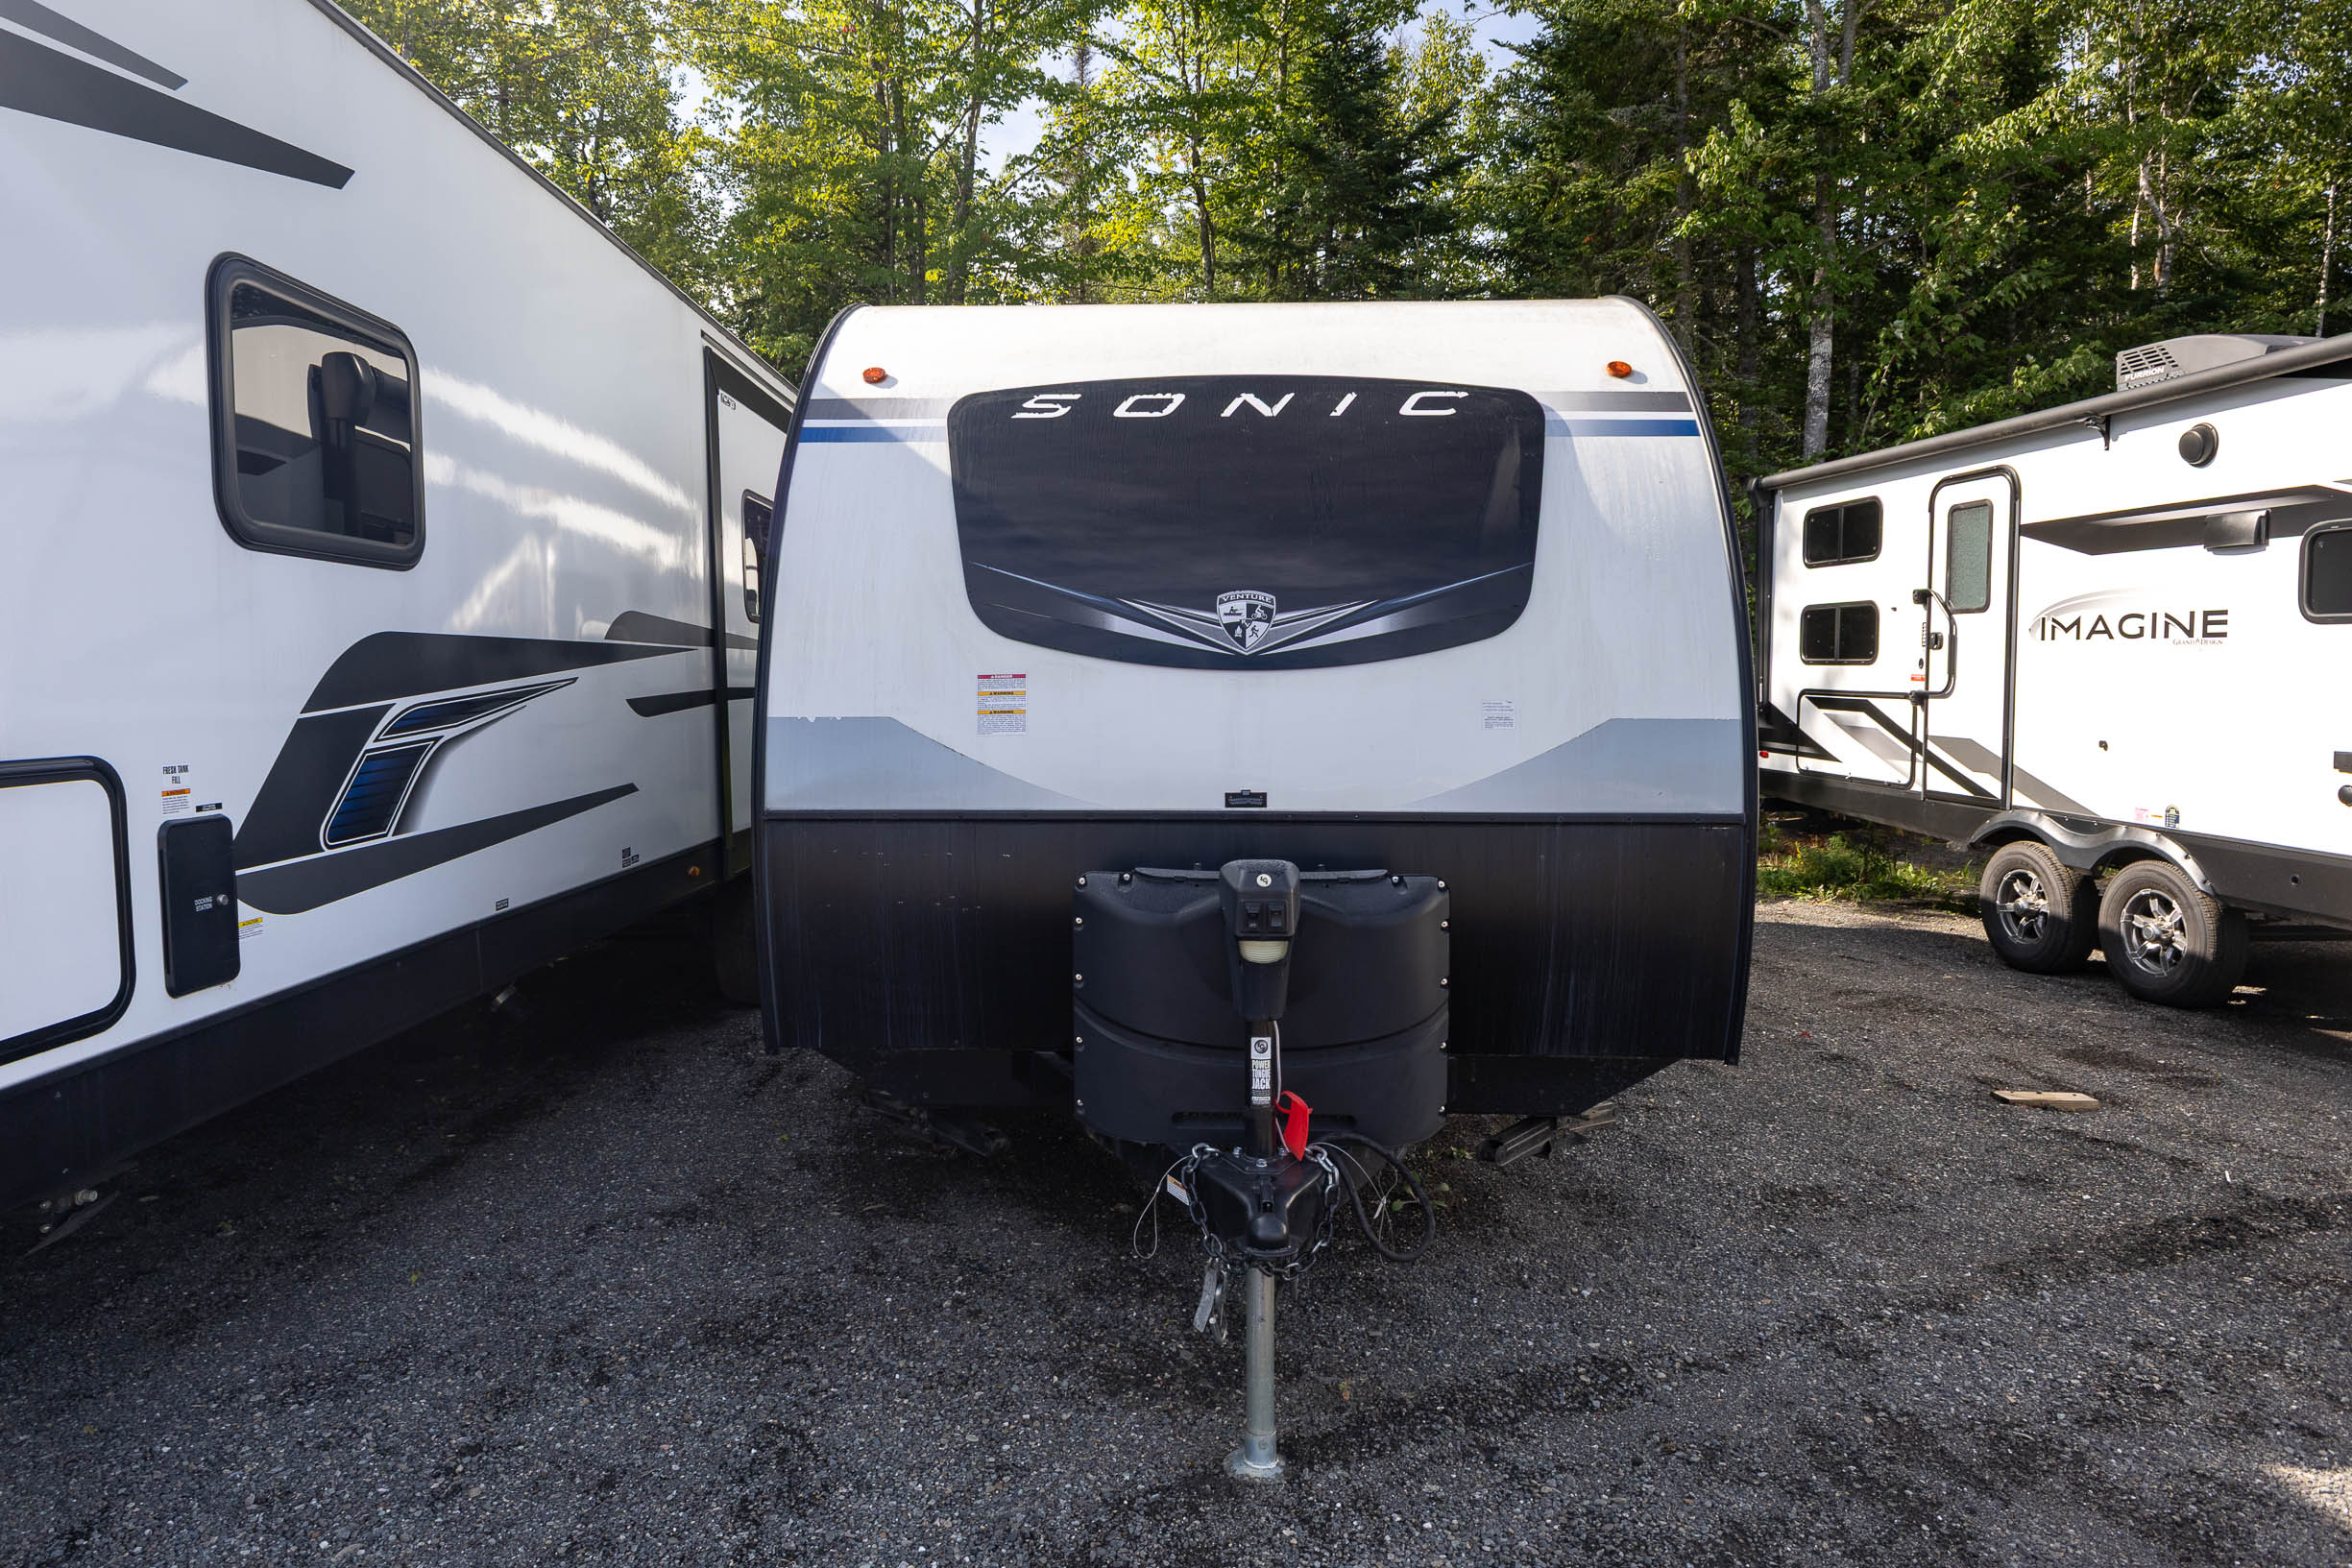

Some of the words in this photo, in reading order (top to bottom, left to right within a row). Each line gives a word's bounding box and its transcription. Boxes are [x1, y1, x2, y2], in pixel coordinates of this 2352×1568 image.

[2123, 366, 2165, 381] FURRION
[1010, 391, 1469, 418] SONIC
[1222, 593, 1273, 603] VENTURE
[2040, 610, 2229, 640] IMAGINE
[162, 765, 177, 775] FRESH
[178, 764, 189, 773] TANK
[194, 896, 213, 905] DOCKING
[195, 903, 213, 912] STATION
[1252, 1060, 1271, 1069] POWER
[1252, 1077, 1271, 1089] JACK
